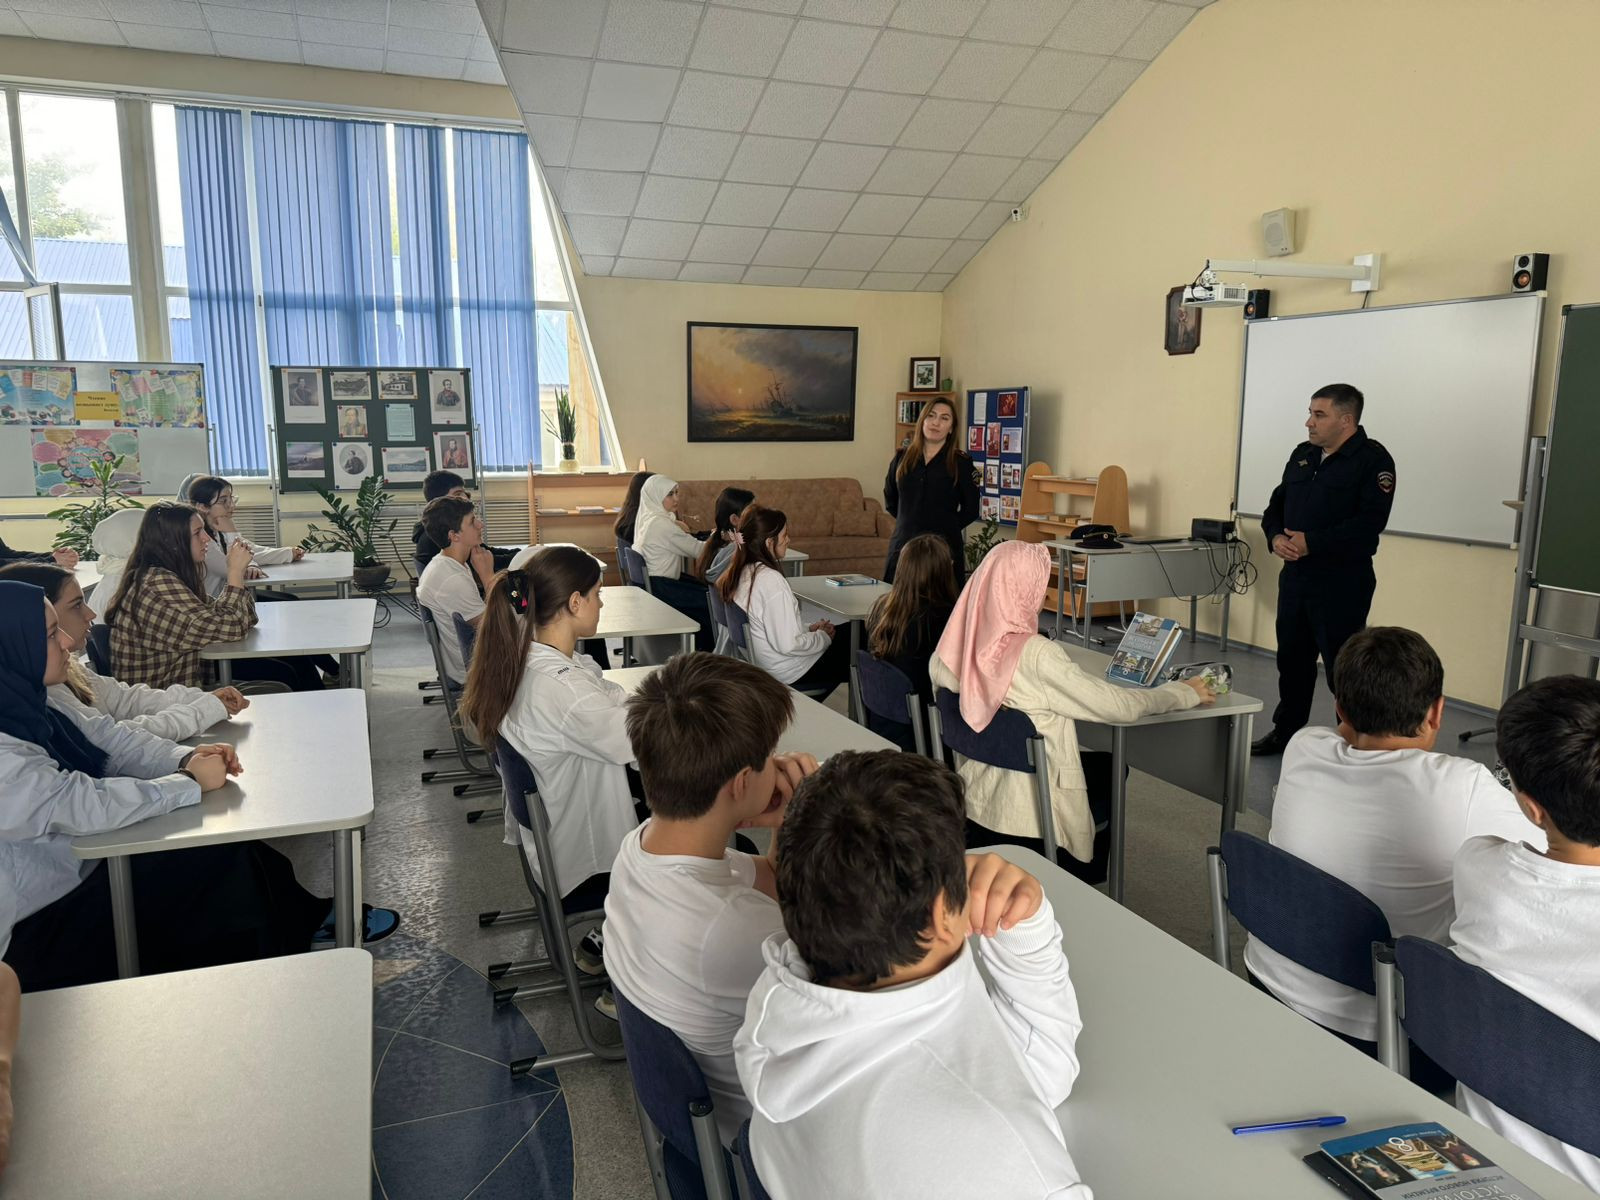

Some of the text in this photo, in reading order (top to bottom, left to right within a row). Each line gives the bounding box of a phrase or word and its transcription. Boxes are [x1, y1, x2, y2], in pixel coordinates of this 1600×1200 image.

[1388, 1136, 1412, 1152] 8
[1402, 1186, 1440, 1199] ВРЕМЕНИ
[1429, 1185, 1505, 1200] ИСТОРИ
[1438, 1180, 1471, 1191] НОВОГО
